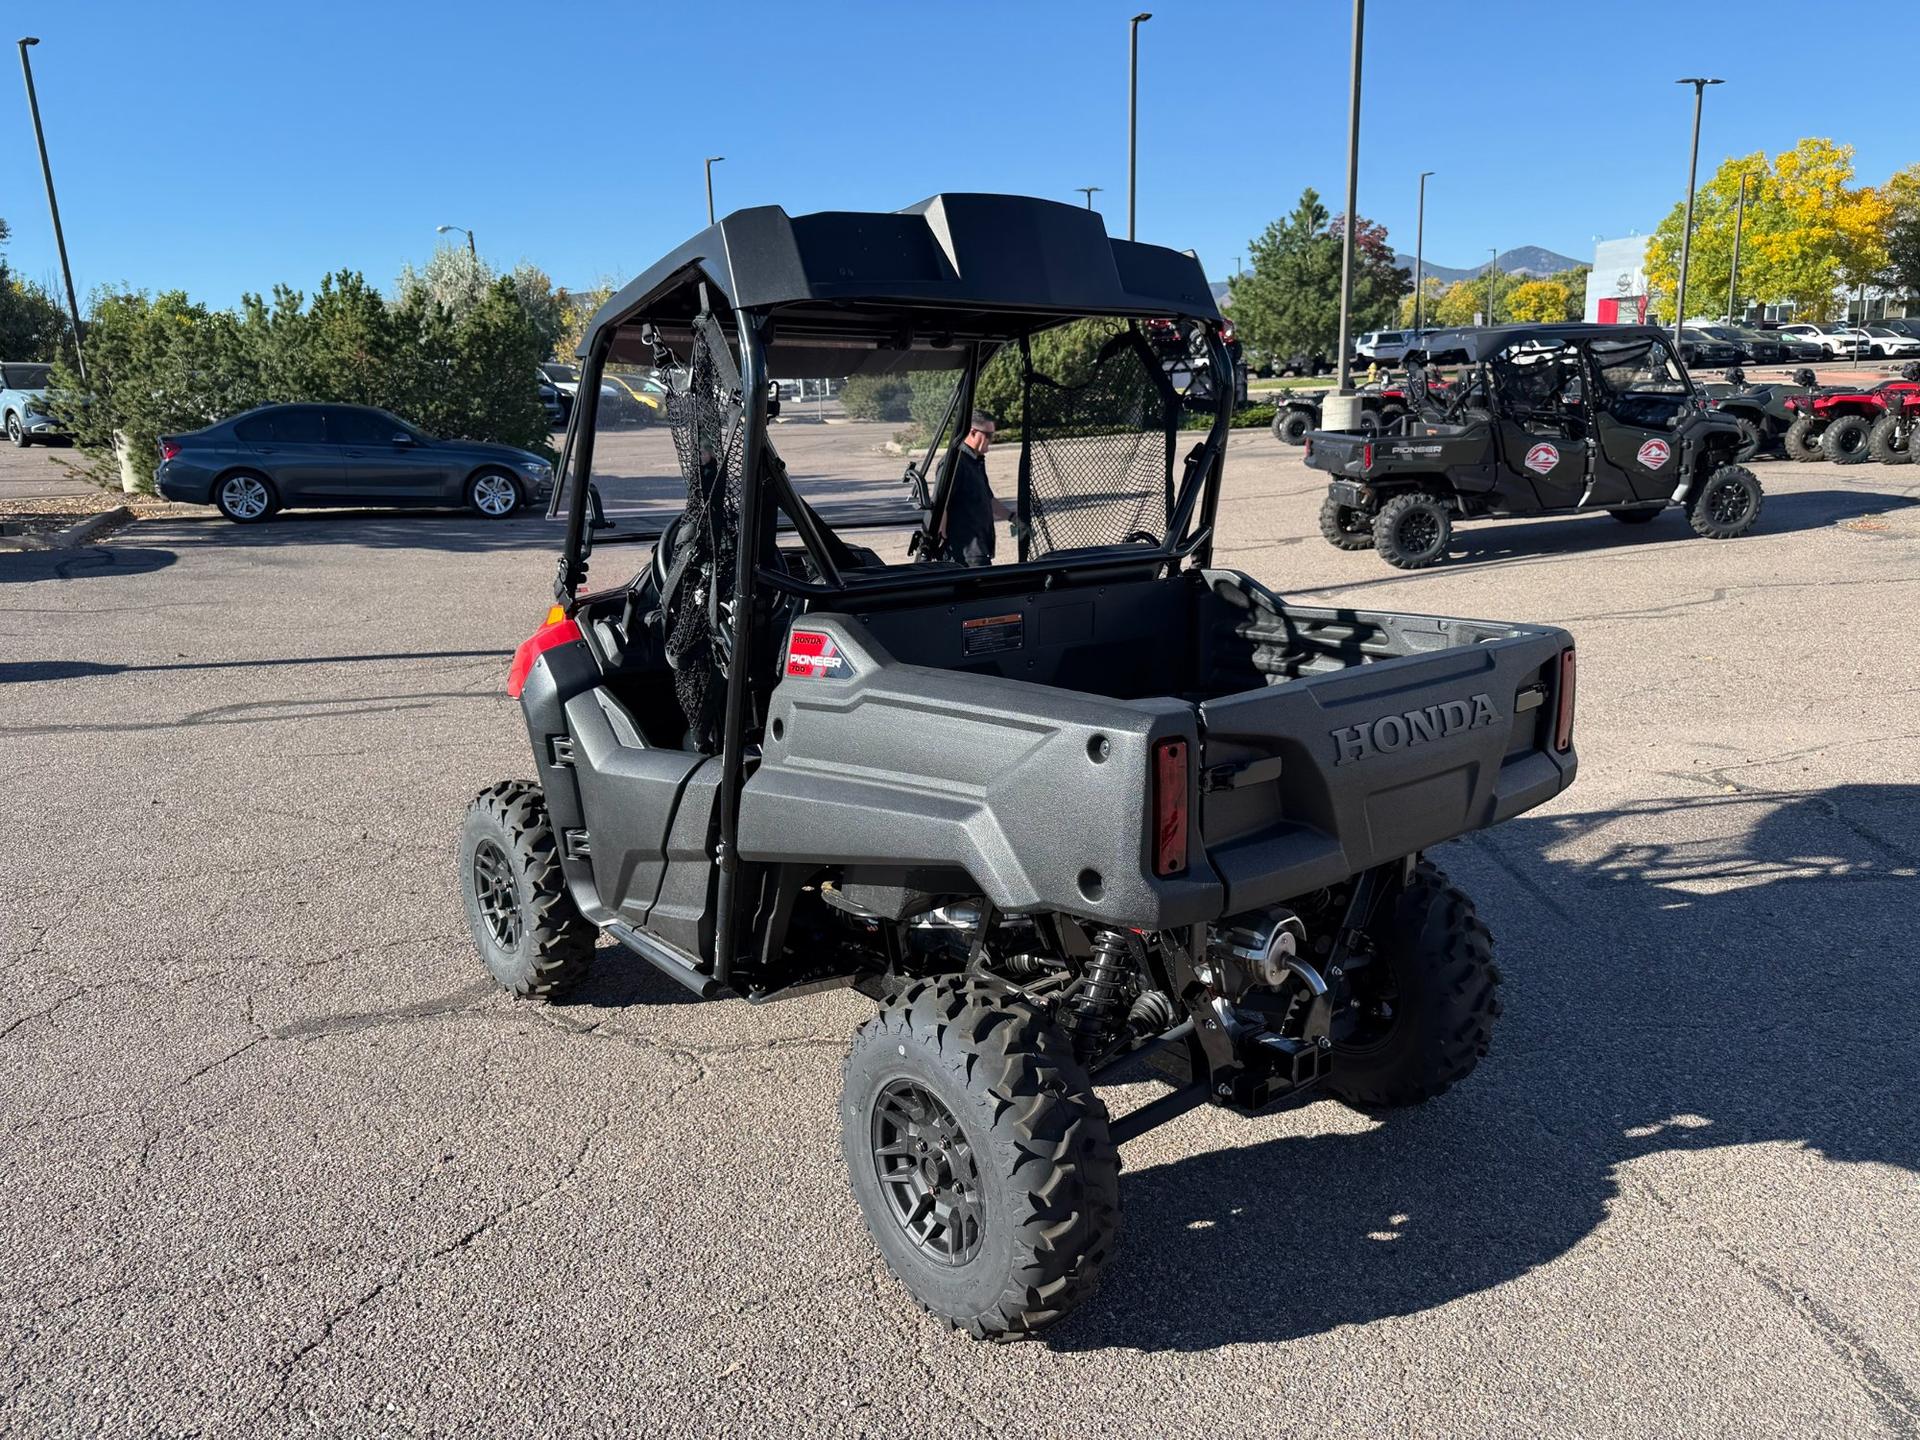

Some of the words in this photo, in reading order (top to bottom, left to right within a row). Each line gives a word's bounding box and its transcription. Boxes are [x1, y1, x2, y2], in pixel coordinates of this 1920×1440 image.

[1391, 445, 1442, 454] PIONEER
[793, 636, 822, 645] HONDA
[789, 653, 842, 668] PIONEER
[1331, 693, 1503, 767] HONDA
